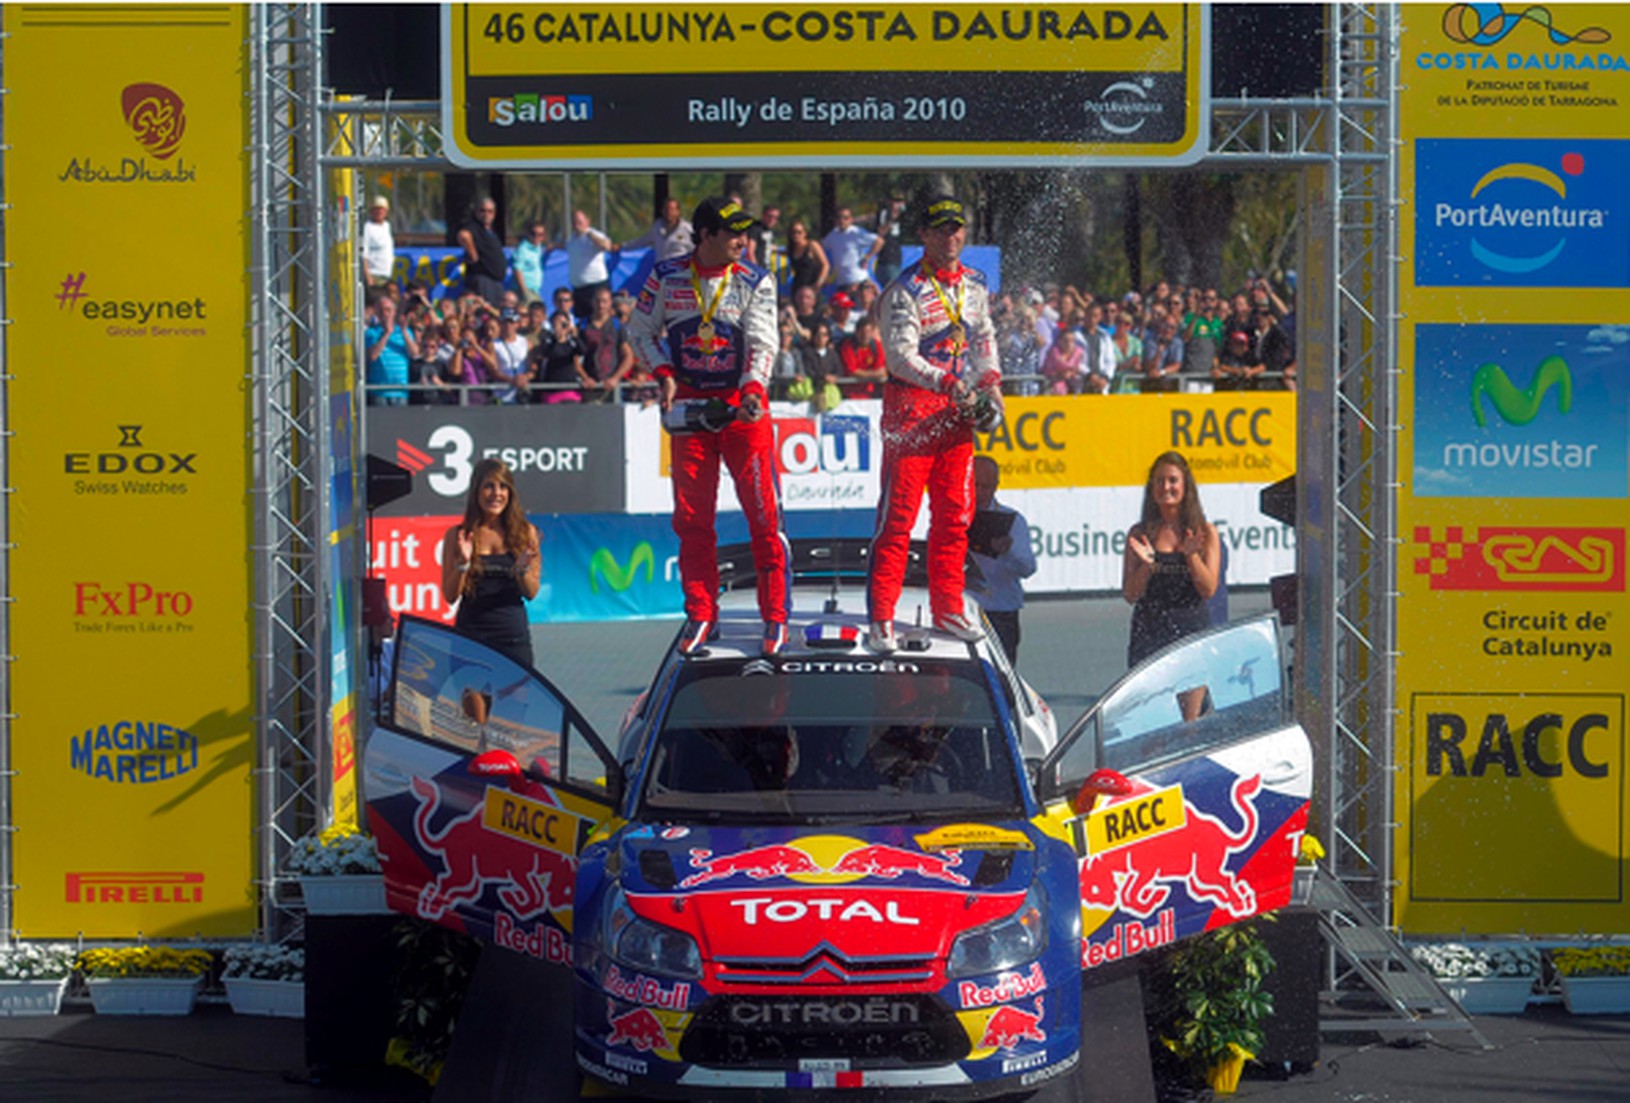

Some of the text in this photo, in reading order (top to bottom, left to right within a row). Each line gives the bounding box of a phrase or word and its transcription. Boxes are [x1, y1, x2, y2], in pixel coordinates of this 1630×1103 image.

[484, 12, 525, 43] 46
[932, 10, 1168, 41] DAURADA
[1415, 53, 1630, 71] COSTA DAURADA
[1466, 79, 1590, 91] PATRONAT DE TURISME
[493, 98, 588, 126] Salou
[689, 98, 966, 127] Rally de España 2010
[1437, 96, 1454, 106] DE
[1456, 97, 1468, 106] LA
[1532, 97, 1547, 106] DE
[1548, 96, 1618, 107] TARRAGONA
[1435, 203, 1604, 228] PortAventura
[106, 325, 207, 338] Global Services
[973, 411, 1066, 452] ACC
[1170, 408, 1272, 447] RACC
[65, 453, 197, 474] EDOX
[428, 425, 474, 496] 3
[1443, 440, 1598, 468] movistar
[74, 480, 188, 495] Swiss Watches
[1028, 523, 1128, 557] Busine
[73, 582, 194, 617] FxPro
[1482, 610, 1607, 631] Circuit de
[1482, 637, 1612, 662] Catalunya
[1425, 713, 1609, 778] RACC
[501, 799, 559, 845] RACC
[1105, 797, 1167, 843] RACC
[65, 872, 205, 903] PIRELLI
[730, 897, 920, 925] TOTAL
[495, 910, 544, 960] Red
[1123, 907, 1176, 958] Bull
[639, 977, 691, 1011] Bull
[959, 972, 1012, 1010] Red
